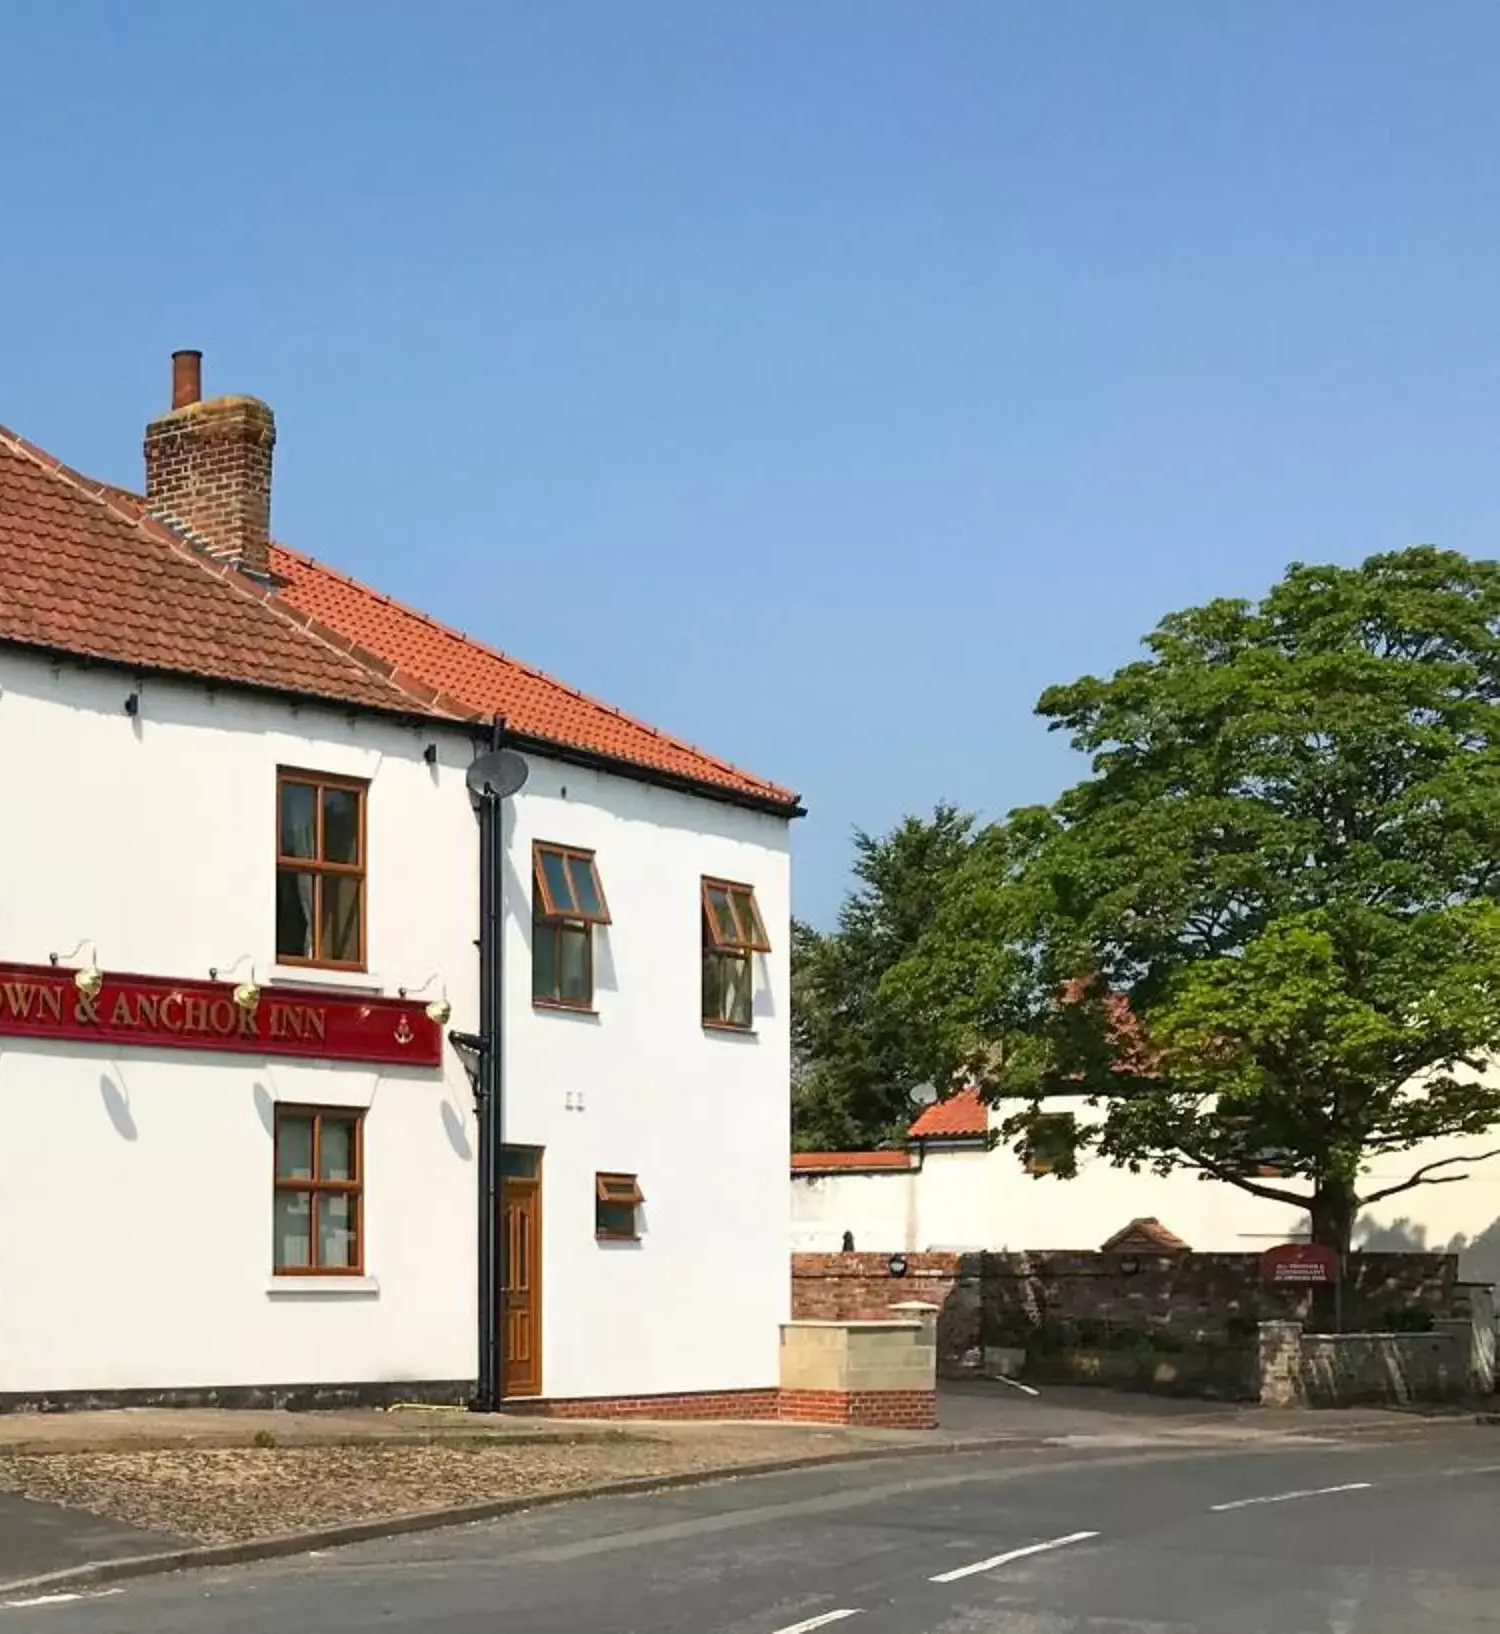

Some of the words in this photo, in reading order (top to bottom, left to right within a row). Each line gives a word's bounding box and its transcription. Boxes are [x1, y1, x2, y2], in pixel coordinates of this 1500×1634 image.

[73, 989, 100, 1024] &
[111, 992, 259, 1035] ANCHOR
[270, 1004, 326, 1040] INN
